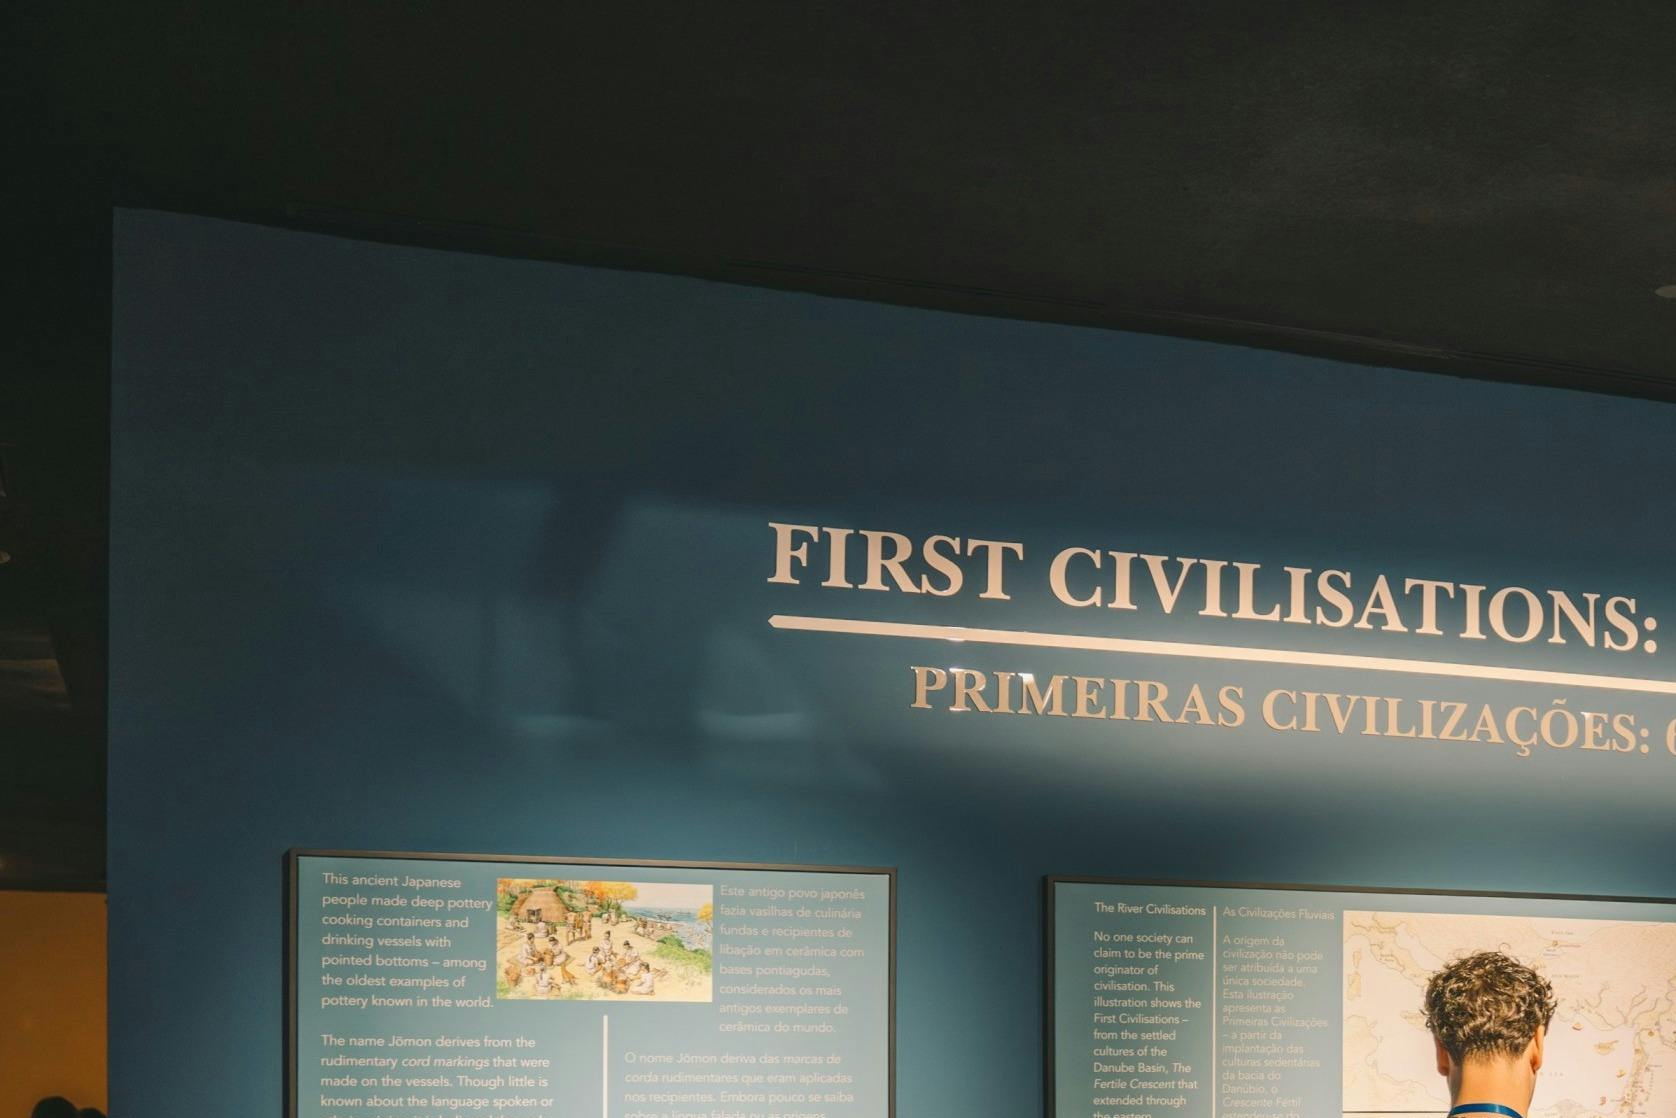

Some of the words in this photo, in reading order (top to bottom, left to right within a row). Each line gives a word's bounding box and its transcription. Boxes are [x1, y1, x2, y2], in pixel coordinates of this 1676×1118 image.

[767, 522, 1023, 600] FIRST
[1049, 546, 1658, 654] CIVILISATIONS:
[911, 665, 1244, 727] PRIMEIRAS
[1262, 689, 1650, 757] CIVILIZAÇÕES:
[321, 872, 348, 884] This
[351, 874, 398, 886] ancient
[401, 875, 461, 890] Japanese
[720, 884, 746, 897] Este
[747, 887, 785, 901] antigo
[788, 890, 818, 900] povo
[820, 888, 866, 901] japonês
[322, 893, 367, 908] people
[371, 894, 407, 906] made
[410, 895, 446, 910] deep
[446, 897, 494, 911] pottery
[1094, 901, 1114, 912] The
[1117, 902, 1143, 913] River
[1145, 903, 1206, 915] Civilisations
[720, 904, 746, 917] fazia
[748, 905, 794, 917] vasilhas
[796, 907, 812, 918] de
[814, 908, 862, 920] culinária
[1222, 906, 1236, 916] As
[1237, 906, 1296, 920] Civilizações
[1298, 908, 1336, 920] Fluviais
[321, 913, 373, 928] cooking
[376, 916, 441, 927] containers
[444, 916, 468, 927] and
[322, 935, 374, 949] drinking
[376, 935, 422, 946] vessels
[424, 935, 451, 947] with
[1093, 930, 1110, 941] No
[1135, 932, 1172, 945] society
[1174, 935, 1193, 943] can
[321, 954, 372, 968] pointed
[375, 953, 428, 967] bottoms
[442, 959, 486, 970] among
[1093, 946, 1121, 957] claim
[1124, 949, 1135, 958] to
[1137, 947, 1152, 958] be
[1154, 948, 1172, 959] the
[1174, 949, 1204, 962] prime
[1093, 964, 1144, 977] originator
[1146, 964, 1158, 975] of
[320, 973, 342, 985] the
[345, 973, 386, 986] oldest
[388, 975, 449, 990] examples
[452, 975, 466, 987] of
[1094, 979, 1150, 991] civilisation.
[1152, 980, 1175, 991] This
[320, 995, 368, 1008] pottery
[371, 994, 412, 1007] known
[416, 995, 427, 1006] in
[431, 995, 452, 1006] the
[454, 995, 494, 1008] world.
[1093, 995, 1147, 1007] illustration
[1150, 997, 1182, 1008] shows
[1184, 997, 1201, 1008] the
[1093, 1012, 1116, 1023] First
[1118, 1012, 1180, 1024] Civilisations
